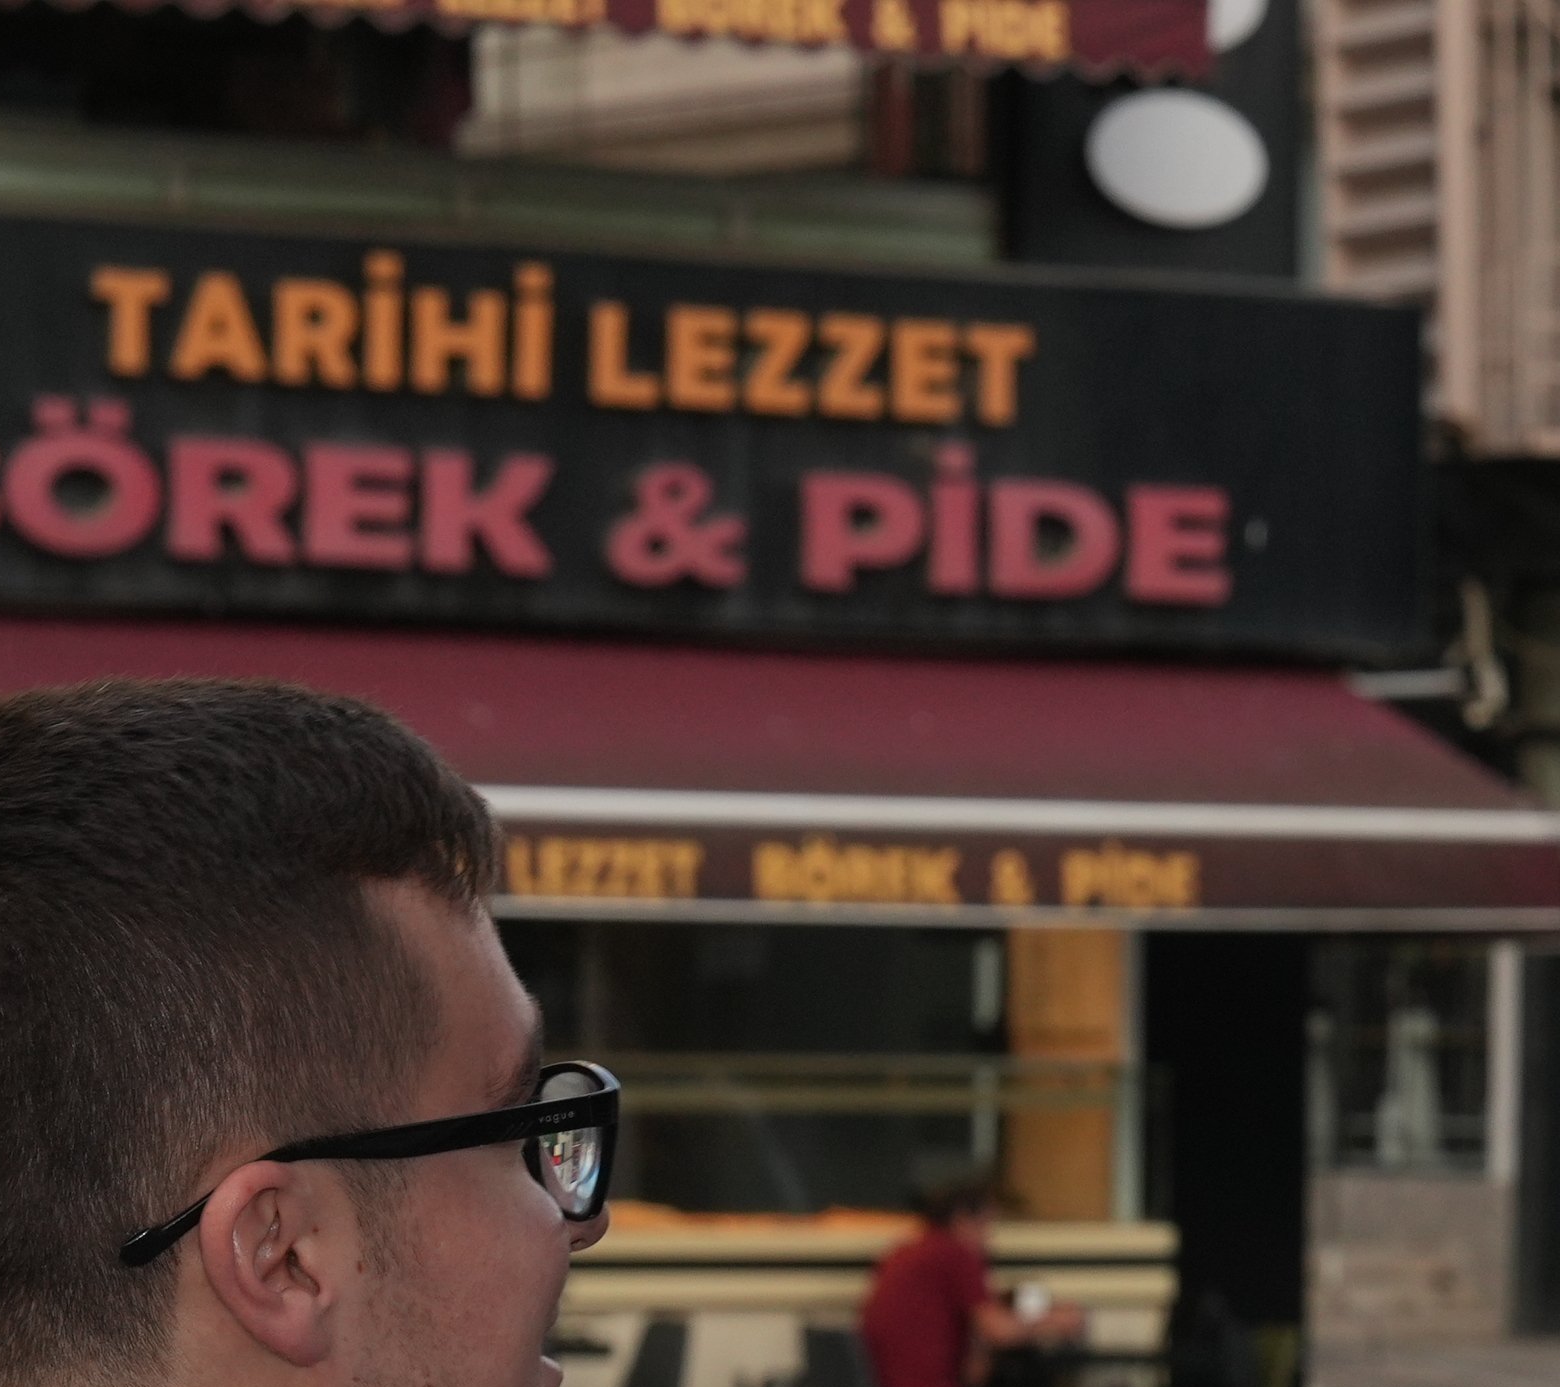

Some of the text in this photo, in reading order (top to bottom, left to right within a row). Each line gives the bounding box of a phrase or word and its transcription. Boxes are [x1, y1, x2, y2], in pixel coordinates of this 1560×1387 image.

[91, 247, 1035, 427] TARİHİ LEZZET
[606, 458, 748, 590] &
[798, 444, 1236, 606] PİDE
